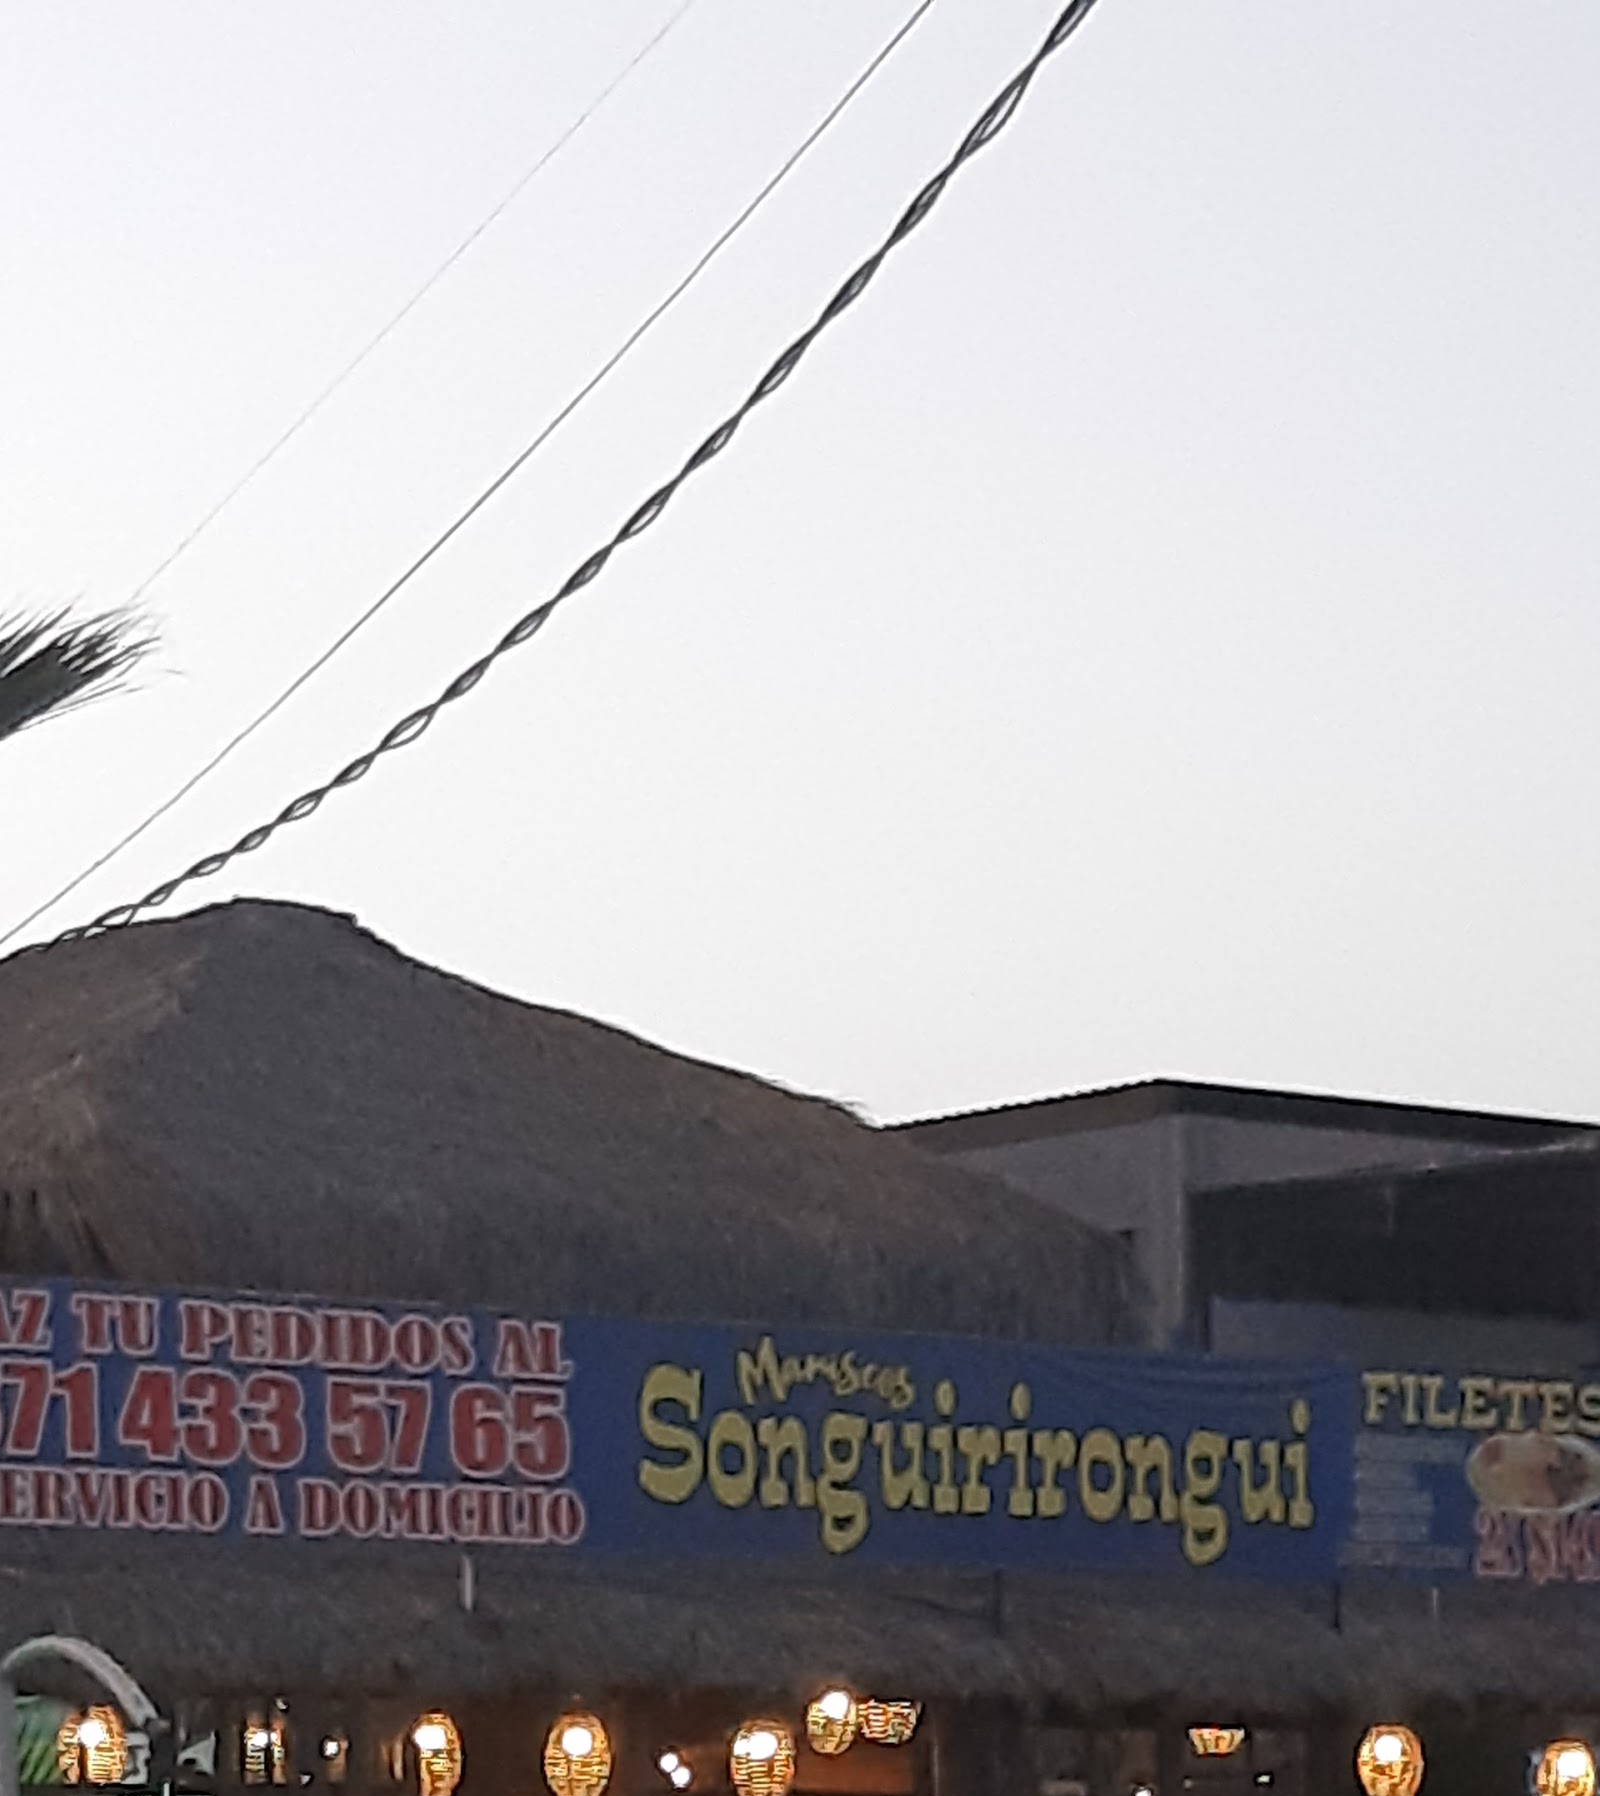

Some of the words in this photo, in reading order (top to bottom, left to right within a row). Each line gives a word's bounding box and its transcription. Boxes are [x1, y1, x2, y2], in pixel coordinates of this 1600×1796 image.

[71, 1290, 161, 1356] TU
[180, 1299, 476, 1376] PEDIDOS
[493, 1317, 573, 1381] AL
[118, 1364, 306, 1468] 433
[326, 1378, 432, 1476] 57
[449, 1385, 571, 1482] 65
[638, 1362, 1314, 1566] Songuirirongui
[245, 1477, 285, 1536] A
[298, 1479, 586, 1546] DOMICILIO
